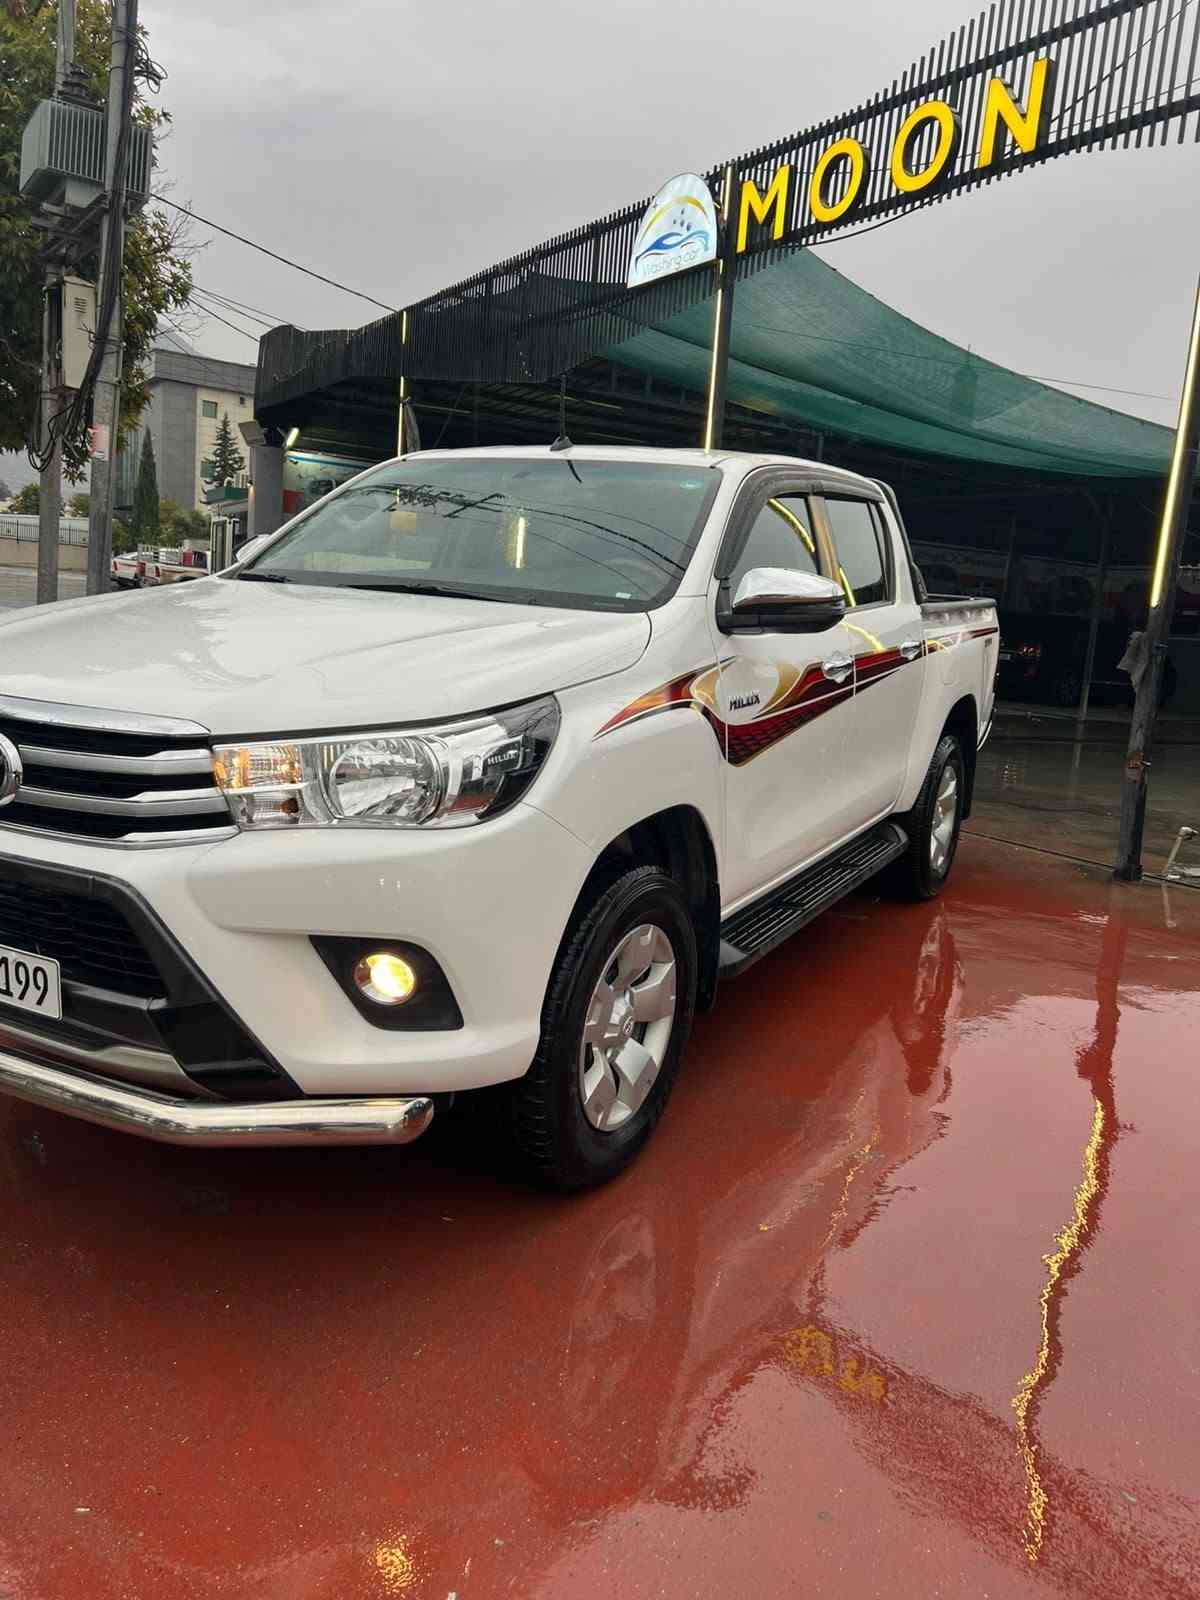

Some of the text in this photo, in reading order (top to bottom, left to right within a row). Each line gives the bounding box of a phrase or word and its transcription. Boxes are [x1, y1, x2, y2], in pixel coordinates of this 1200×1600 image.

[736, 57, 1054, 254] MOON
[729, 694, 760, 711] HILUX
[487, 750, 518, 765] HILUX
[0, 956, 49, 1006] 199
